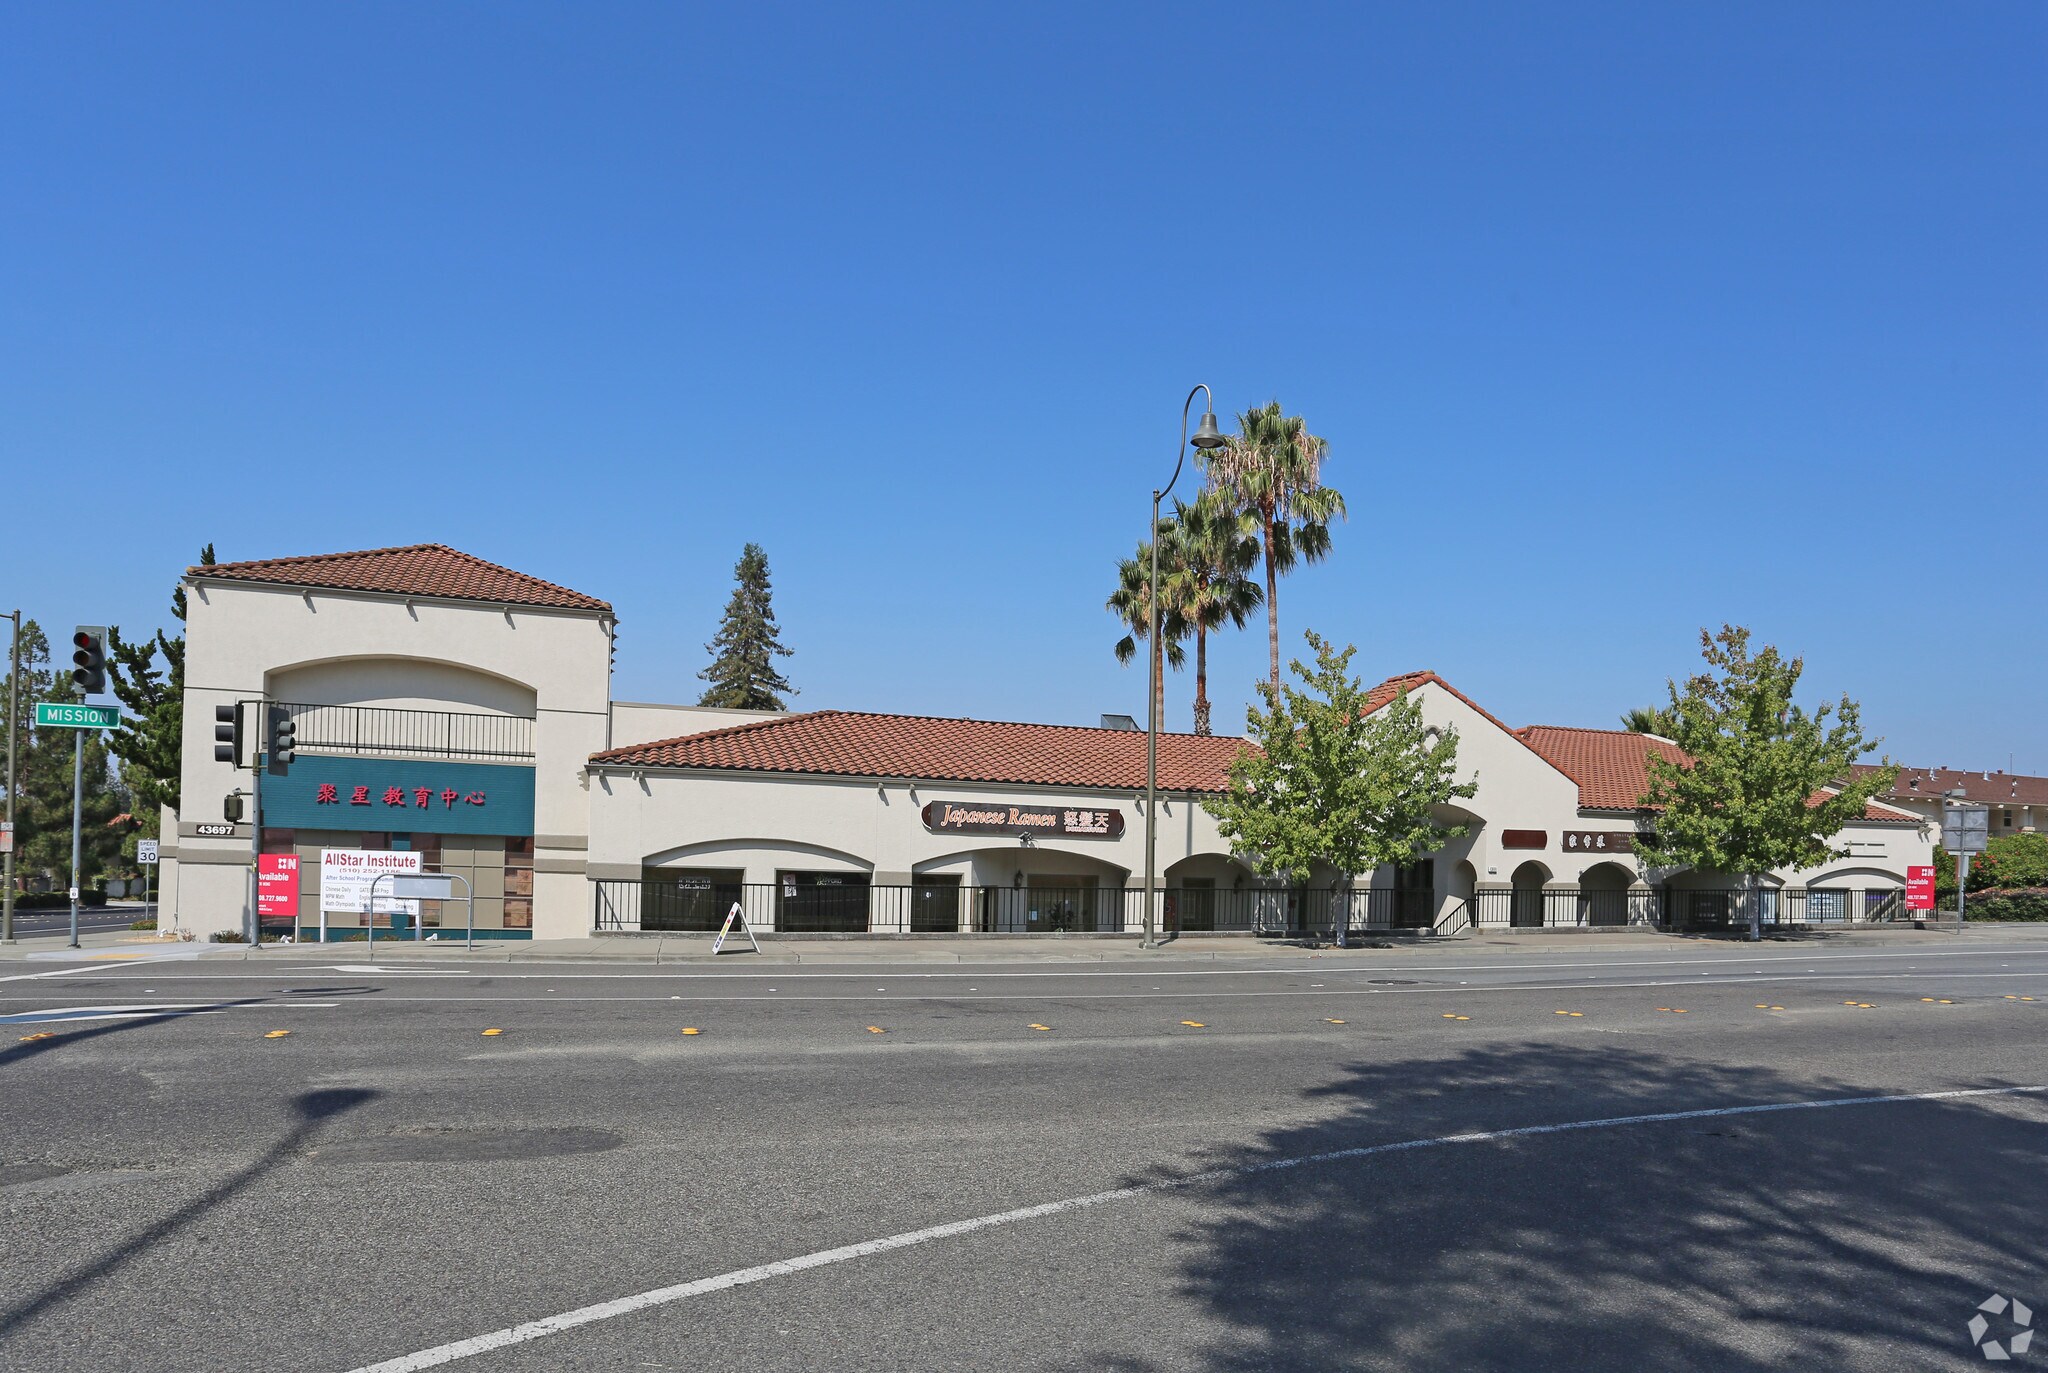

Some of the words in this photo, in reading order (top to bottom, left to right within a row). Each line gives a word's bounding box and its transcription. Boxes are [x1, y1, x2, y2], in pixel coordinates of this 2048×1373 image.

[47, 709, 109, 724] MISSION
[316, 783, 485, 809] 聚星教育中心
[941, 805, 1005, 827] Japanese
[1008, 807, 1056, 827] Ramen
[198, 825, 233, 835] 43697
[140, 852, 155, 861] 30
[325, 853, 364, 867] AllStar
[367, 854, 416, 868] Institute
